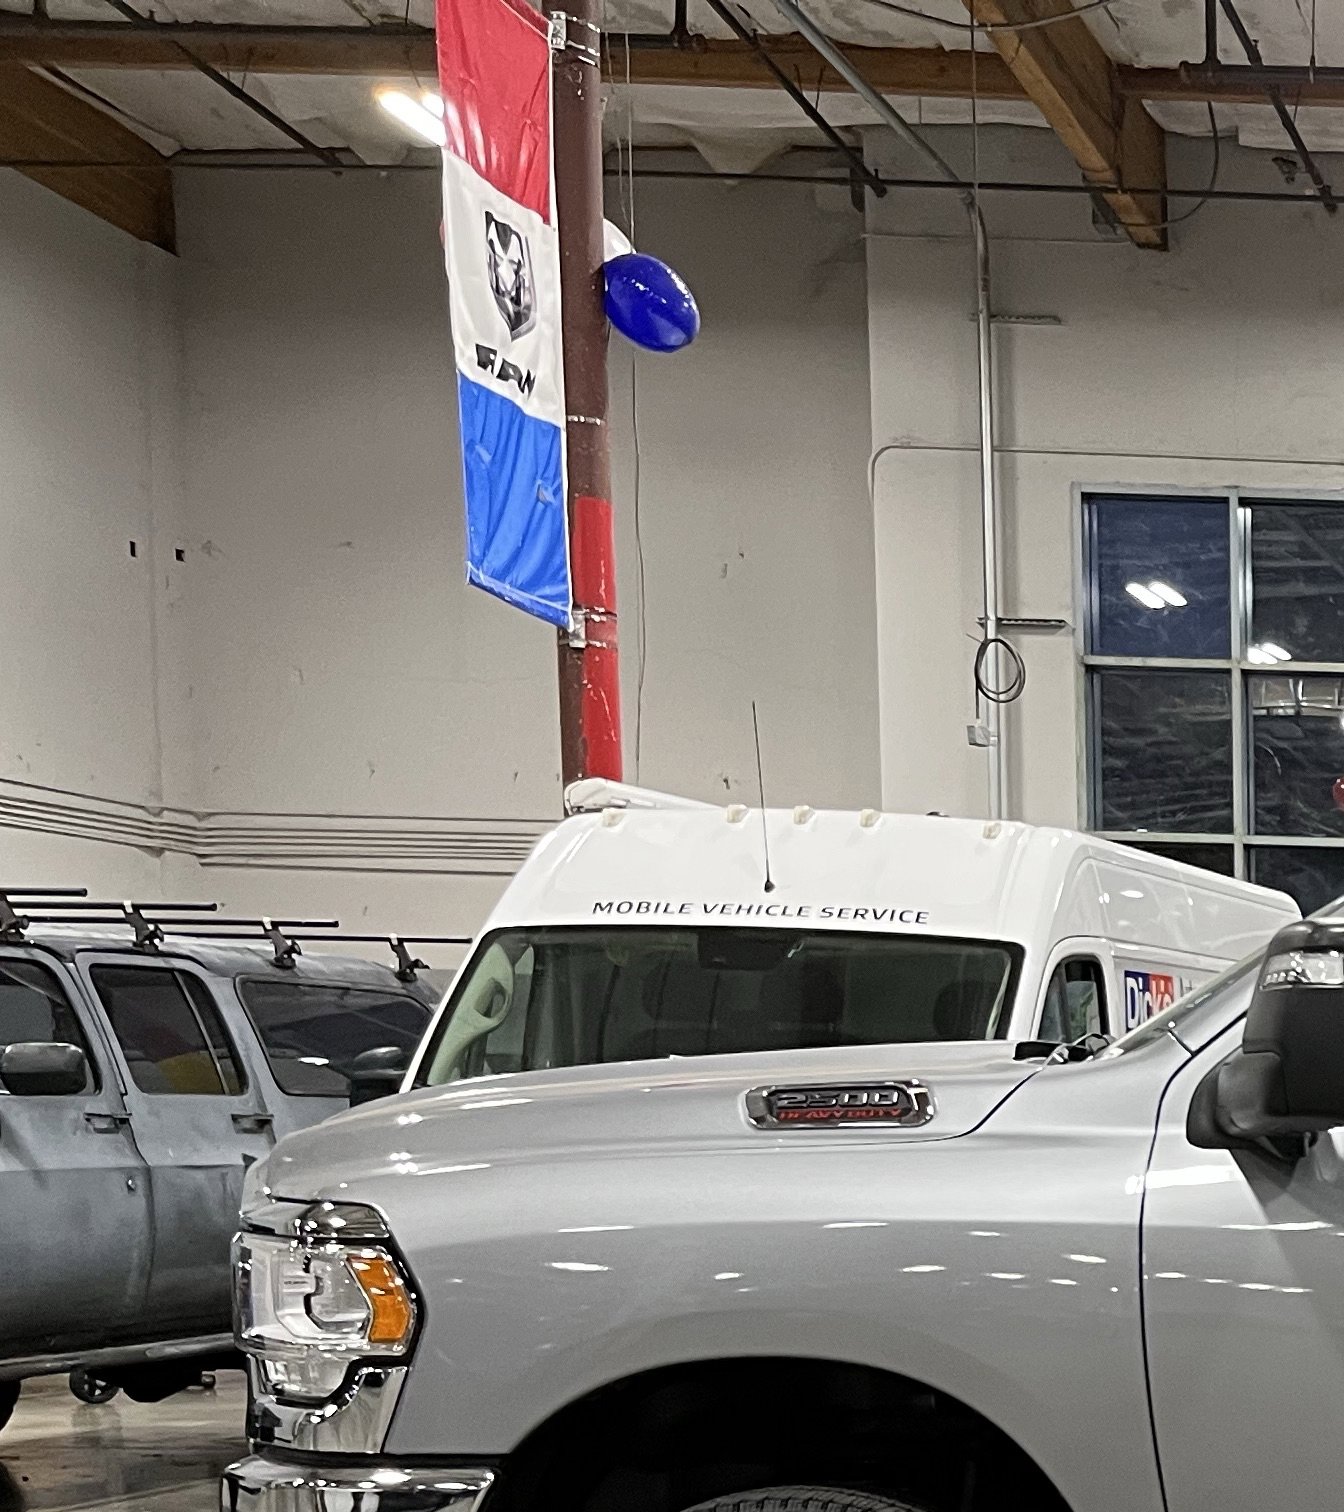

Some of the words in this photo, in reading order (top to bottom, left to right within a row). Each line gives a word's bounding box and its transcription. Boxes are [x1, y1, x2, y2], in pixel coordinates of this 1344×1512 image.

[592, 900, 695, 916] MOBILE
[702, 902, 812, 919] VEHICLE
[819, 906, 930, 926] SERVICE
[776, 1090, 900, 1108] 2500
